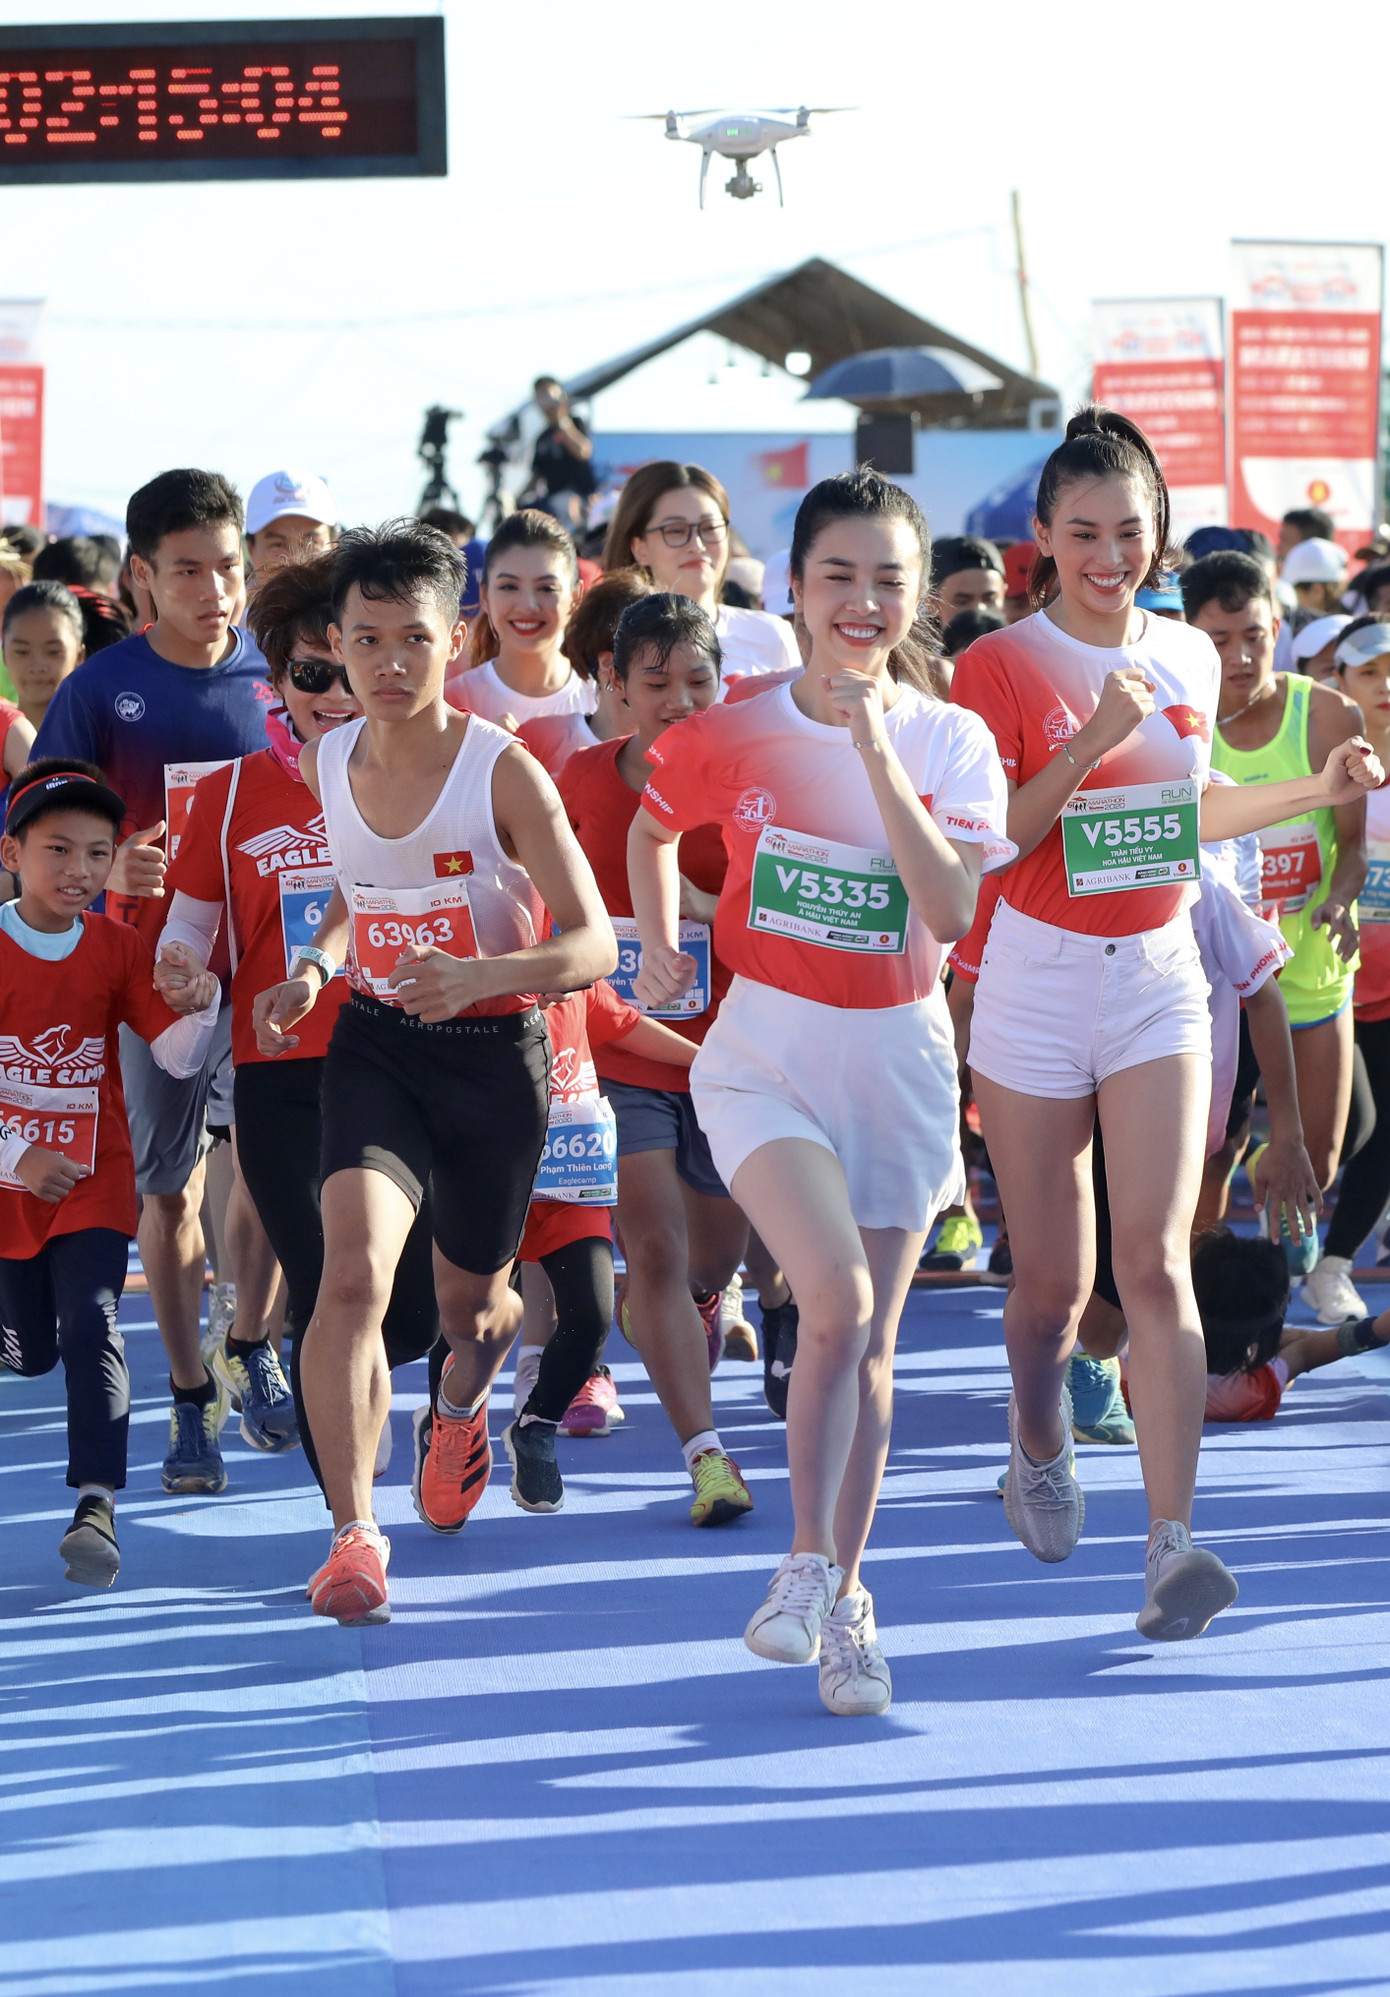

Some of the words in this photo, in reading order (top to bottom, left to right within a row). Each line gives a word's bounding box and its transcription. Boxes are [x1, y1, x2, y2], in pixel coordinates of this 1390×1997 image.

[1161, 787, 1192, 800] RUN
[945, 815, 976, 832] TIEN
[1080, 813, 1182, 849] V5555
[1144, 846, 1154, 854] VY
[870, 858, 897, 868] RU
[1102, 859, 1117, 867] HOA
[1147, 853, 1163, 861] NAM
[1085, 872, 1131, 887] AGRIBANK
[775, 864, 890, 910] V5335
[444, 896, 463, 905] KM
[840, 918, 858, 927] NAM
[849, 912, 862, 920] AN
[367, 917, 454, 948] 63963
[768, 917, 822, 938] AGRIBANK
[687, 931, 704, 939] KM
[56, 1064, 106, 1085] CAMP
[594, 1162, 613, 1172] Long
[558, 1177, 597, 1186] Eaglecamp
